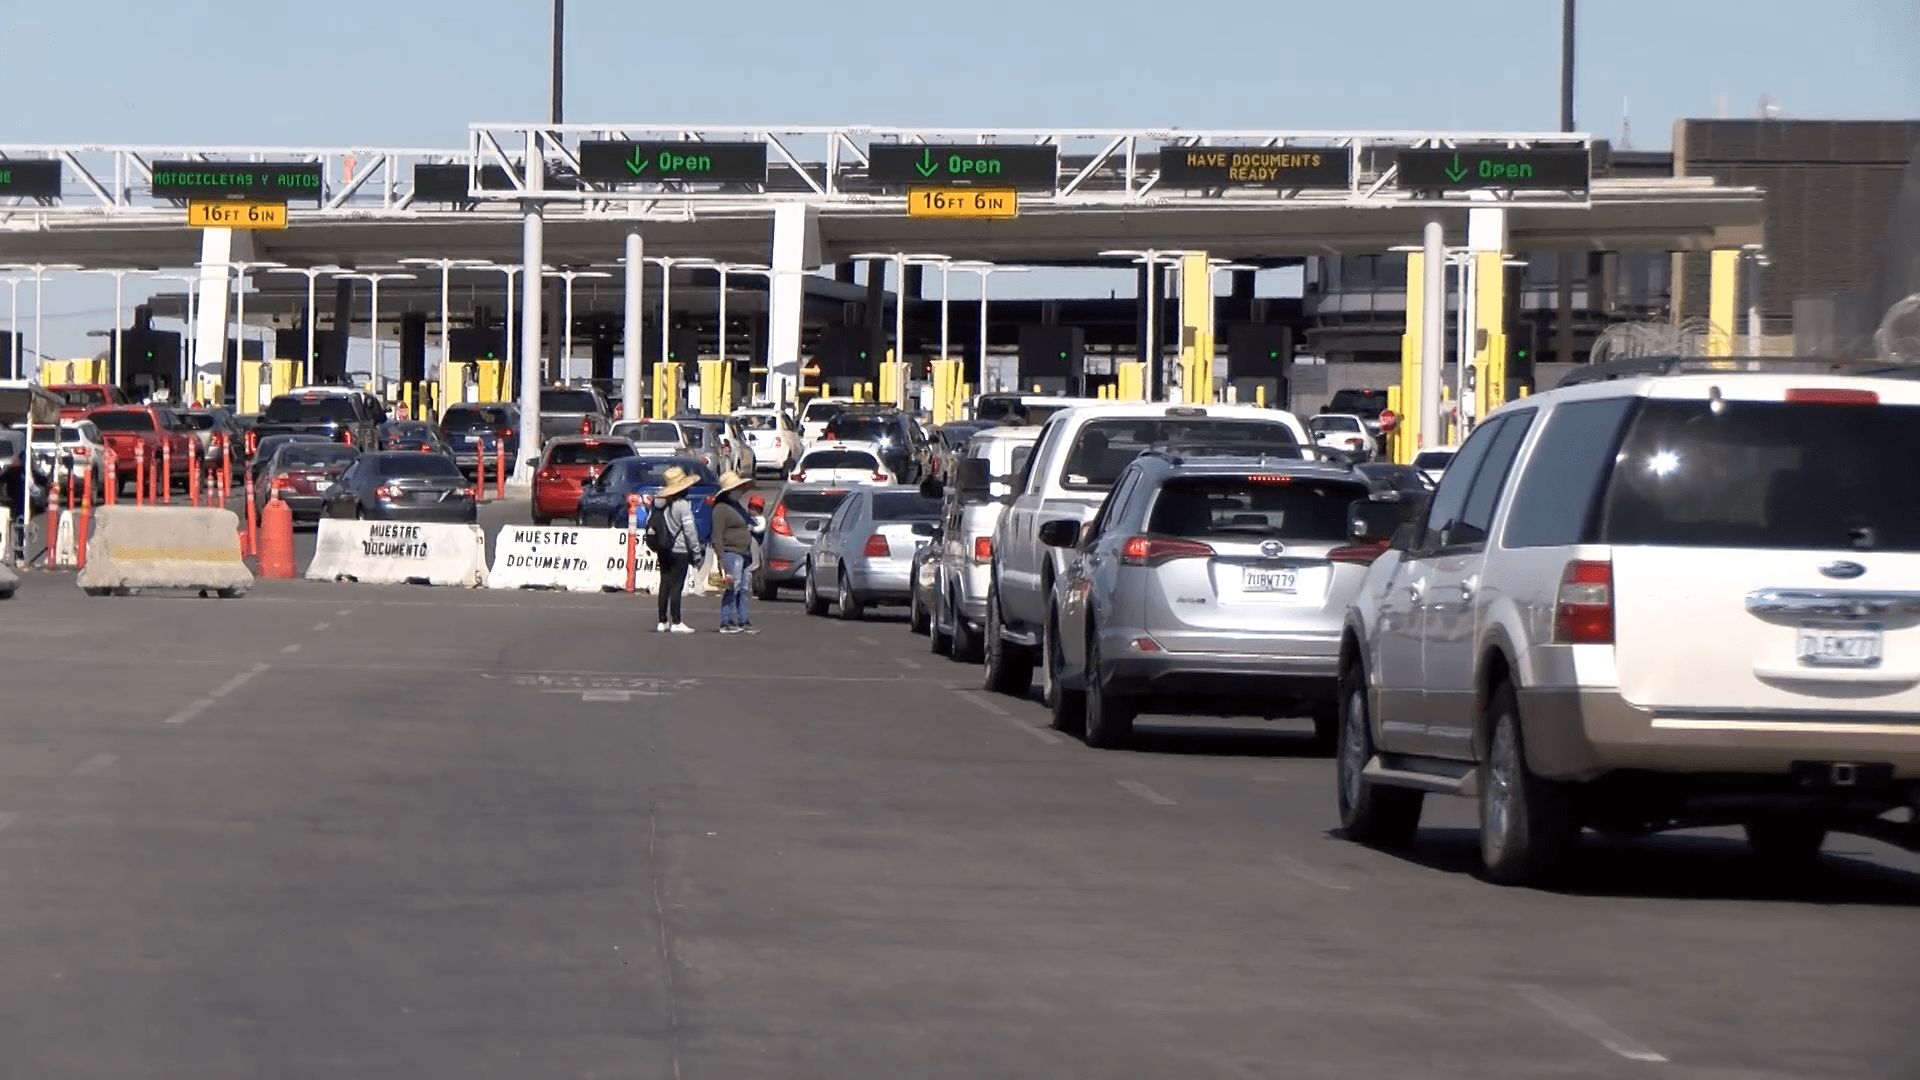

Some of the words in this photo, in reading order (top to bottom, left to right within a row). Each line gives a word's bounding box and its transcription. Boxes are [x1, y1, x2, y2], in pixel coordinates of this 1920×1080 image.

[659, 152, 711, 171] Open
[949, 155, 1001, 173] Open
[1187, 154, 1226, 167] HAVE
[1232, 154, 1321, 167] DOCUMENTS
[1229, 168, 1278, 181] READY
[1478, 160, 1533, 178] Open
[154, 172, 253, 186] MOTOCICLETAS
[261, 174, 269, 185] Y
[277, 174, 320, 187] AUTOS
[370, 524, 421, 539] MUESTRE
[514, 530, 578, 545] MUESTRE
[362, 540, 427, 557] DOCUMENTO
[507, 555, 588, 571] DOCUMENTO
